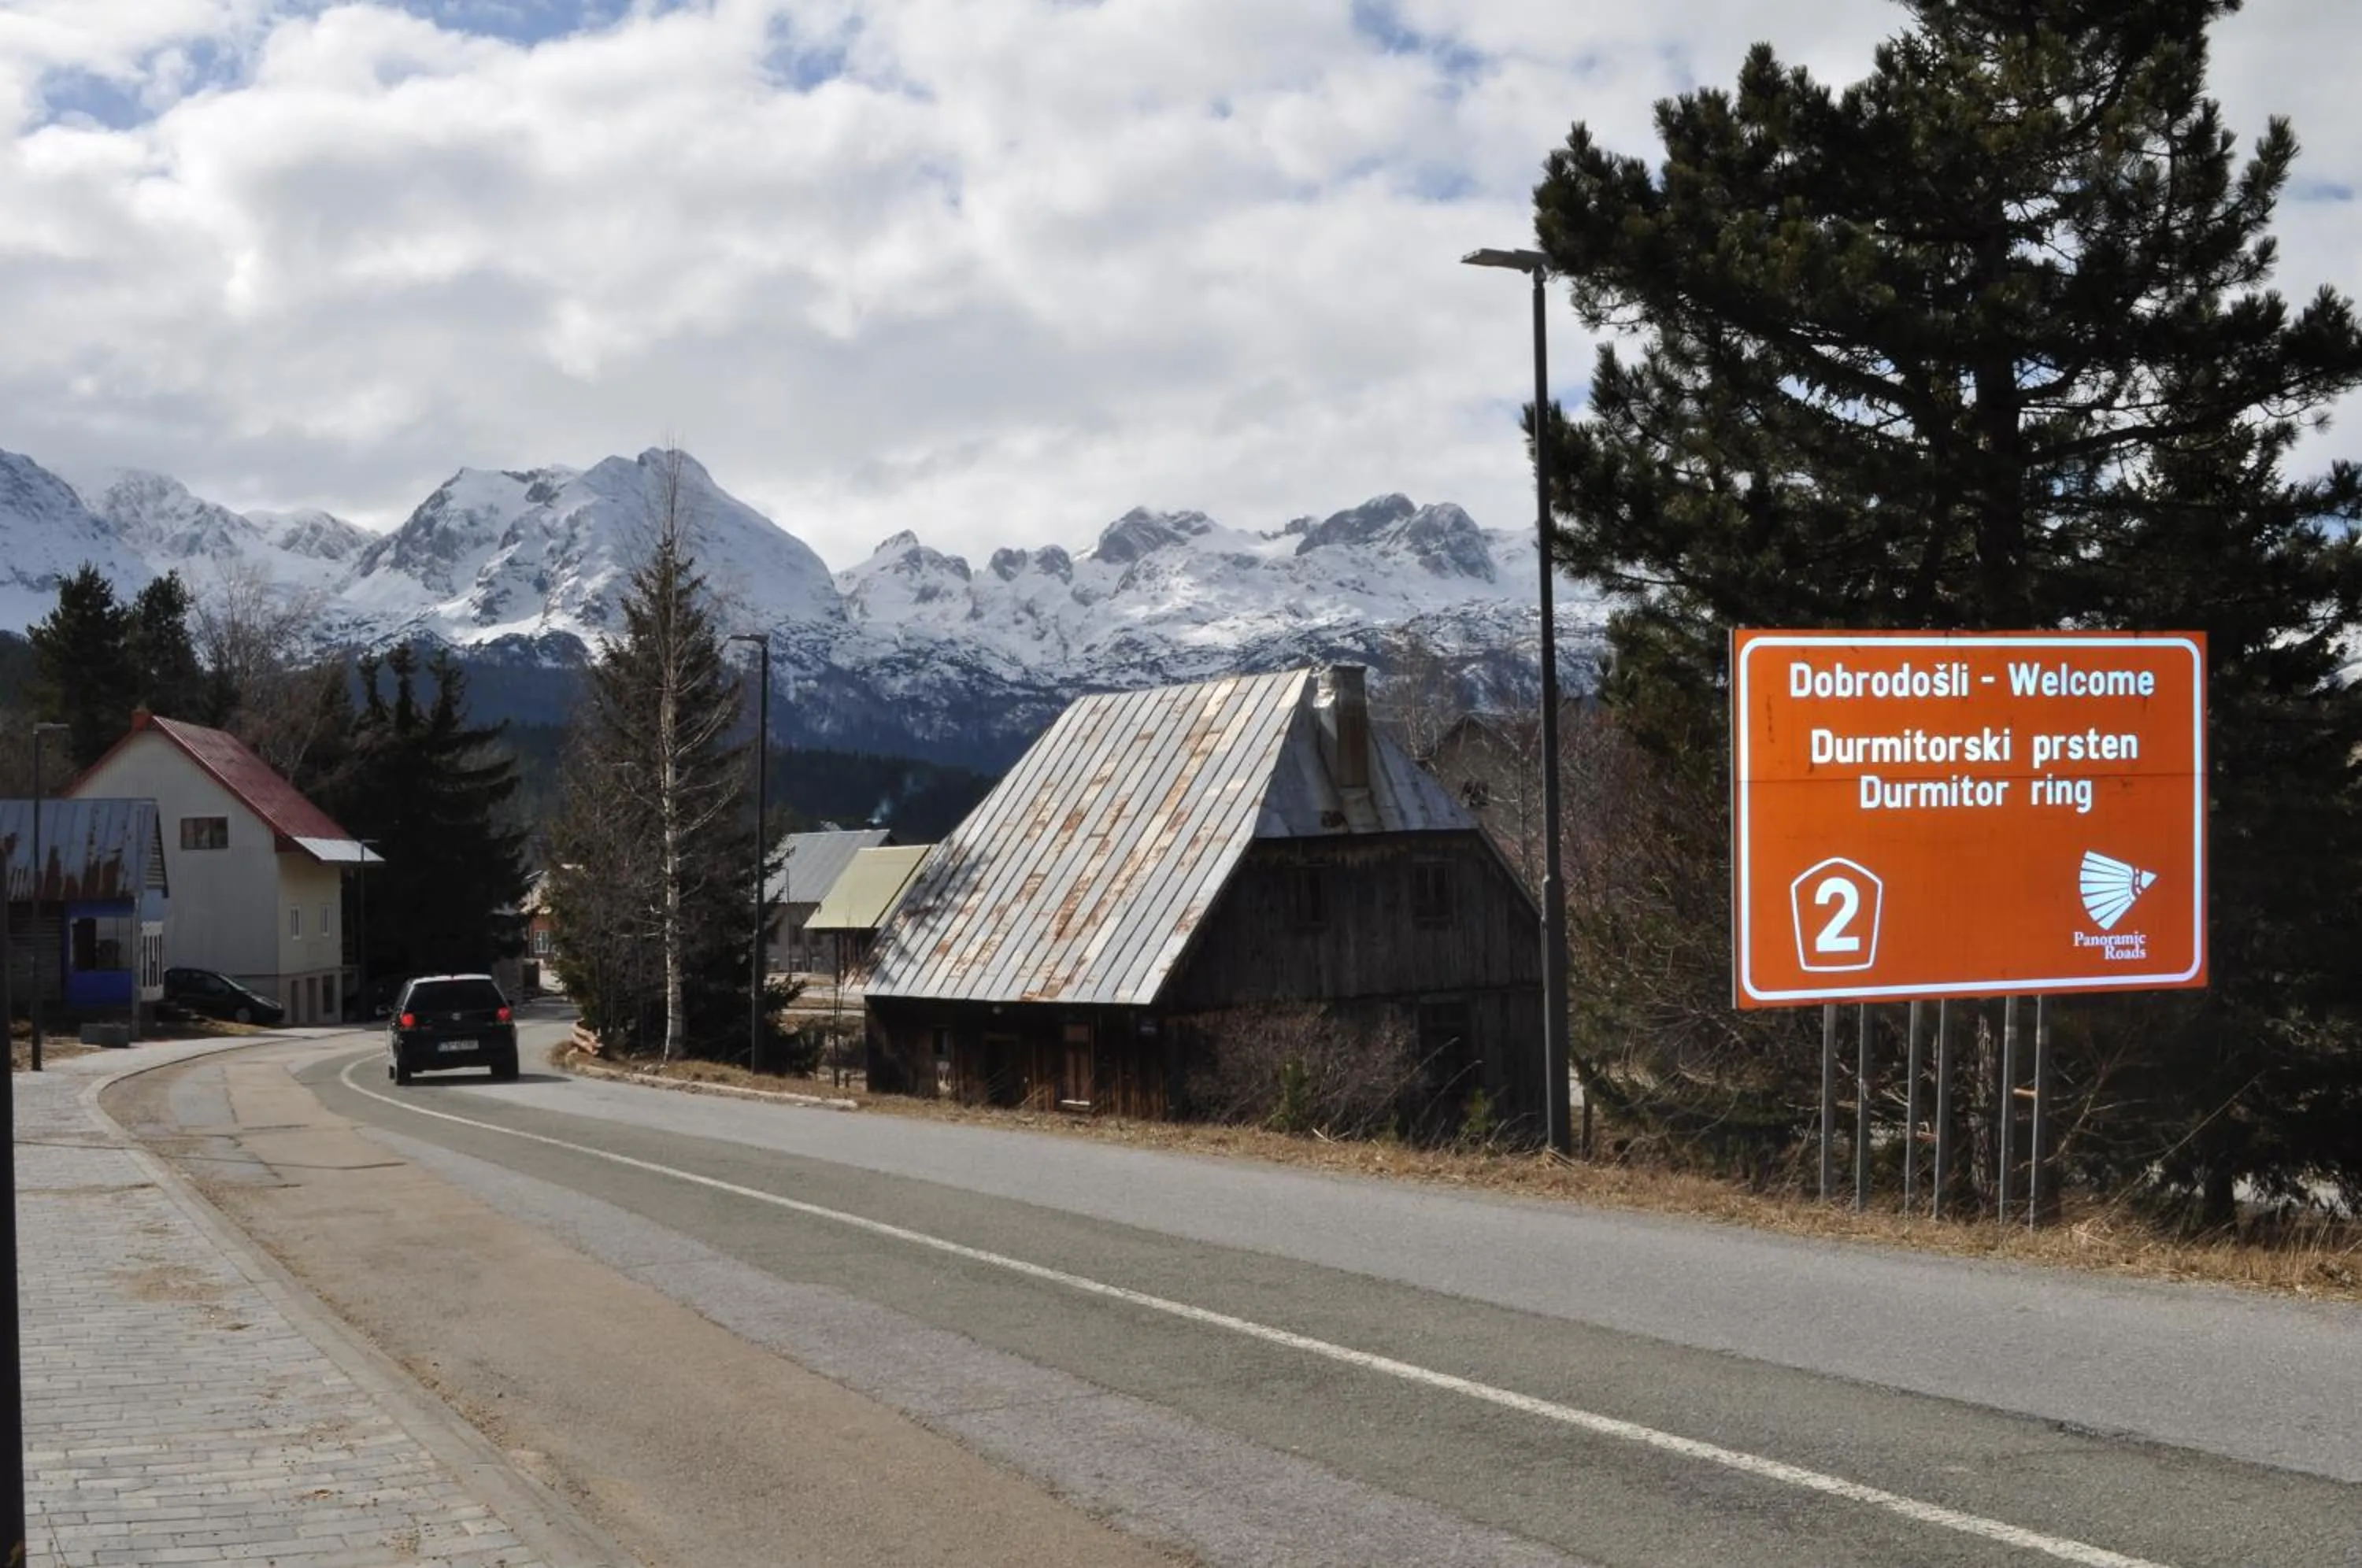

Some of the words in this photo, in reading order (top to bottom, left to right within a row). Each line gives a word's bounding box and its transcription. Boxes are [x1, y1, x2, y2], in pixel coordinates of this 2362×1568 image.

[1789, 661, 1969, 698] Dobrodošli
[2008, 662, 2156, 697] Welcome
[1811, 727, 2011, 764] Durmitorski
[2032, 727, 2139, 769] prsten
[1860, 775, 2010, 809] Durmitor
[2031, 773, 2094, 813] ring
[1814, 877, 1860, 952] 2
[2073, 930, 2147, 947] Panoramic
[2104, 944, 2147, 960] Roads
